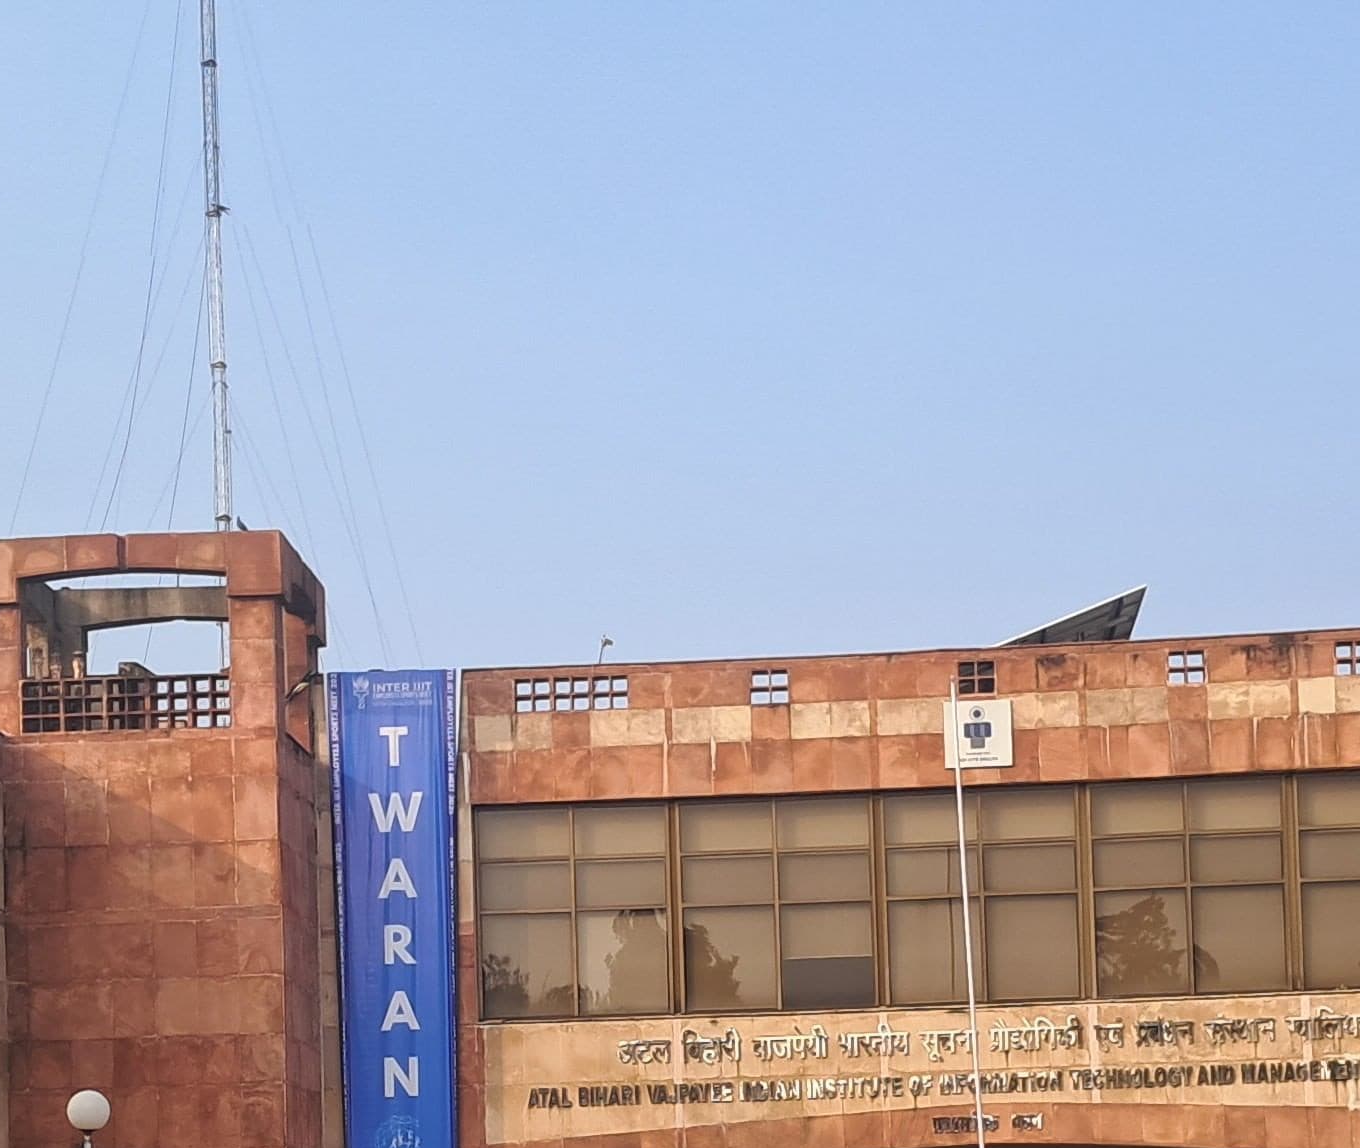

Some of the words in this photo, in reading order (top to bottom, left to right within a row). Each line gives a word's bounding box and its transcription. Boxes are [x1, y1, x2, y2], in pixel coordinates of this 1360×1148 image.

[372, 682, 410, 693] INTER
[413, 681, 433, 691] IIIT
[368, 725, 424, 1100] TWARAN
[616, 1038, 672, 1065] अटल
[682, 1027, 742, 1065] बिहारी
[837, 1023, 910, 1058] भारतीय
[919, 1028, 979, 1063] सूचन
[1094, 1017, 1125, 1053] एवं
[1204, 1013, 1276, 1046] संस्थान
[527, 1086, 573, 1109] ATAL
[577, 1085, 642, 1108] BIHARI
[646, 1081, 734, 1106] VAJPAYEE
[738, 1078, 803, 1103] INDIAN
[806, 1074, 904, 1101] INSTITUTE
[907, 1073, 934, 1098] OF
[1069, 1066, 1194, 1091] TECHNOLOGY
[1197, 1064, 1236, 1086] AND
